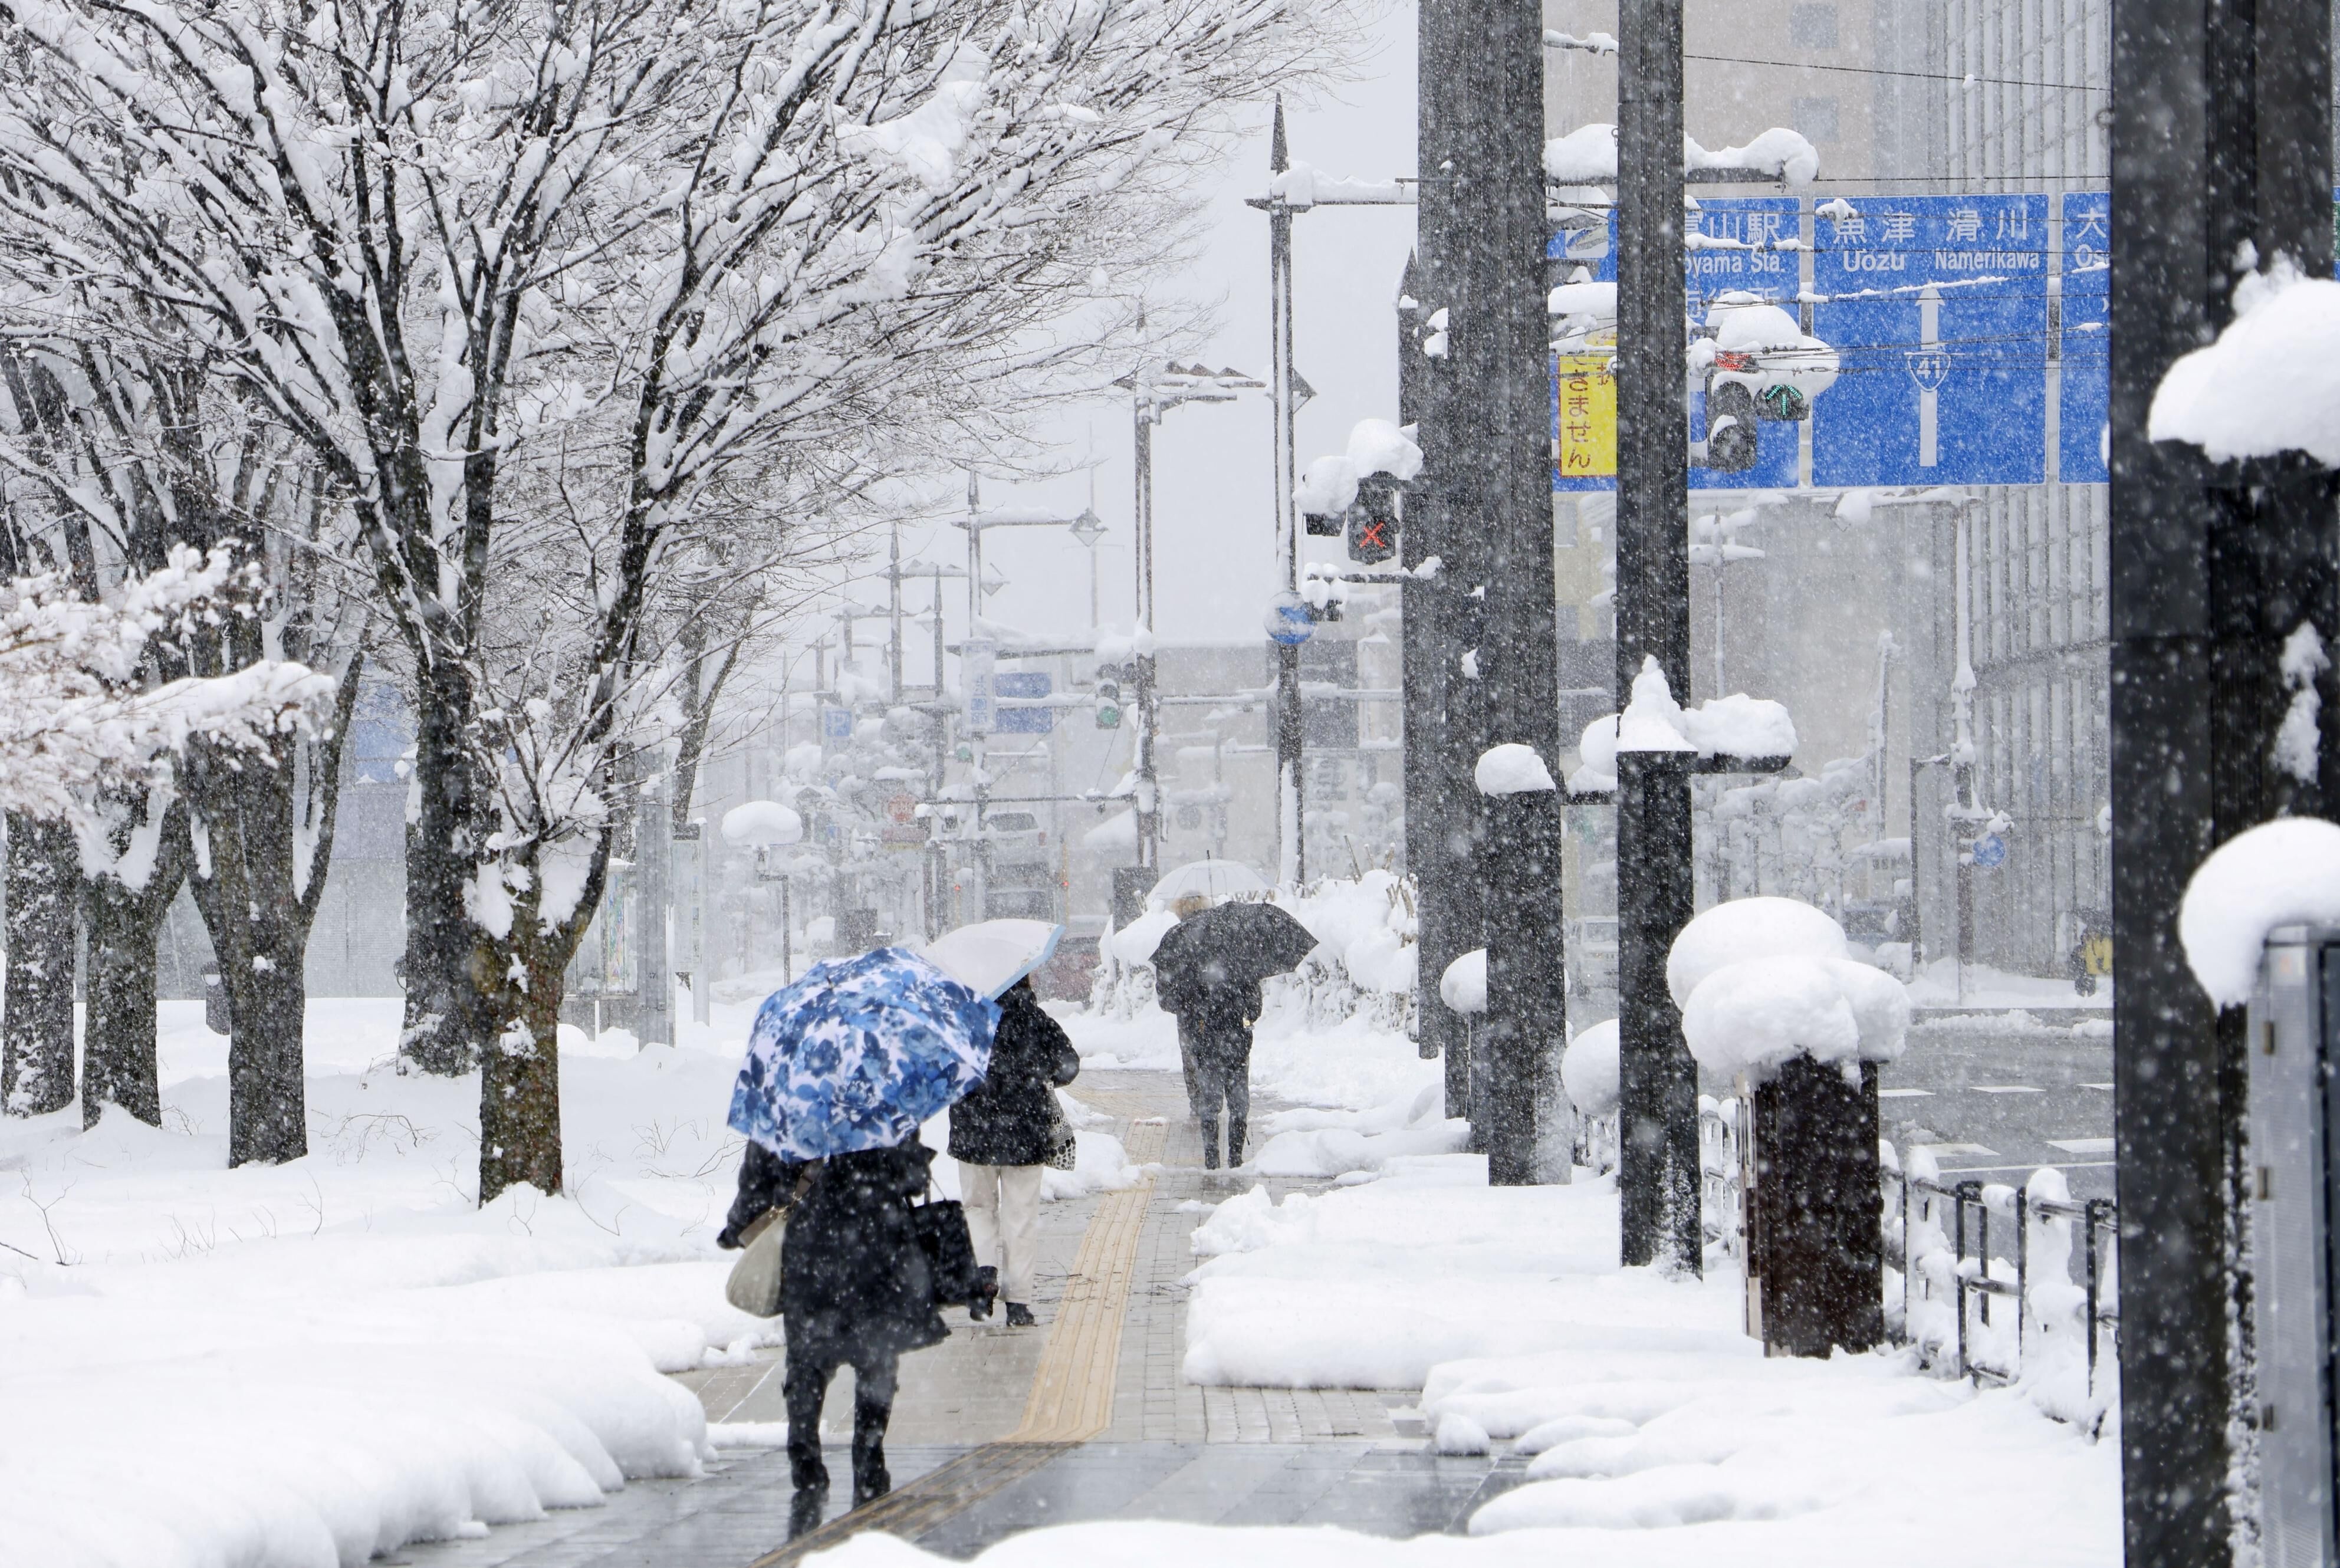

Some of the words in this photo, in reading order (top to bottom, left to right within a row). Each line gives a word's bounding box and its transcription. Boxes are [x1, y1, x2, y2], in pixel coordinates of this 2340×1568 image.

[1946, 209, 2027, 242] 滑川
[2076, 208, 2107, 239] 大
[1750, 248, 1785, 273] Sta.
[1843, 249, 1905, 272] Uozu
[1935, 248, 2040, 270] Namerikawa
[1917, 355, 1940, 379] 41
